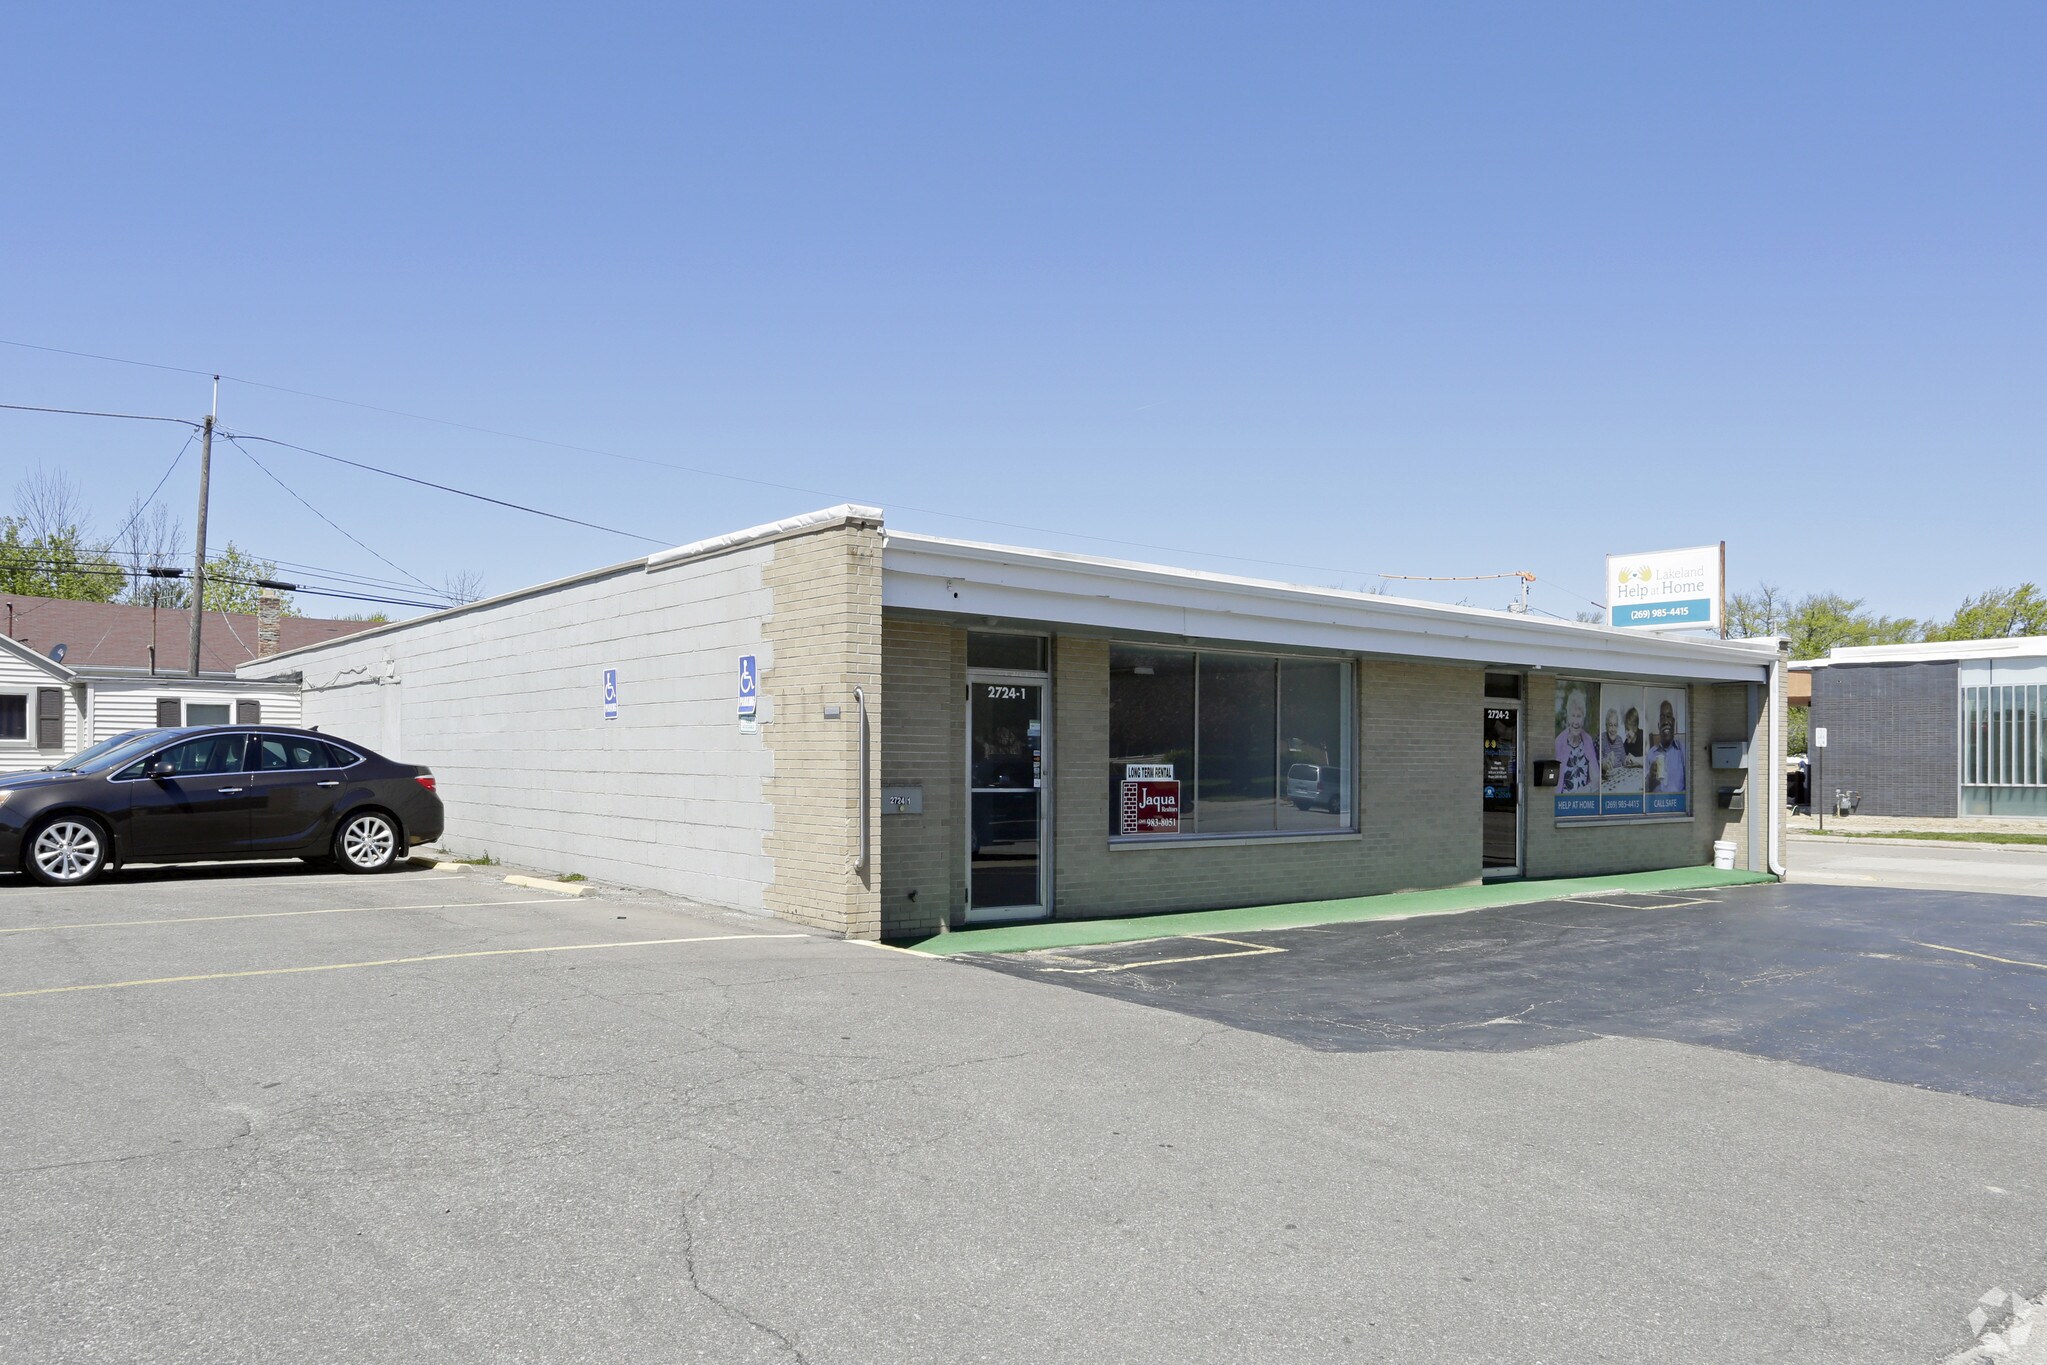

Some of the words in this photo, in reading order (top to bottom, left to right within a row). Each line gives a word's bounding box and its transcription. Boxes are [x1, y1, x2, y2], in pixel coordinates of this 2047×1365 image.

[1656, 565, 1704, 581] Lakeland
[1618, 584, 1648, 599] Help
[1650, 586, 1660, 596] at
[1662, 581, 1704, 594] Home
[1631, 609, 1650, 620] (269)
[1652, 607, 1689, 618] 985-4415
[988, 686, 1026, 700] 2724-1
[1487, 709, 1510, 720] 2724-2
[1128, 767, 1141, 778] LONG
[1142, 767, 1154, 778] TERM
[1155, 767, 1172, 778] RENTAL
[890, 796, 905, 805] 2724
[1139, 788, 1176, 812] Jaqua
[1558, 802, 1571, 810] HELP
[1572, 801, 1579, 809] AT
[1579, 800, 1595, 809] HOME
[1605, 801, 1617, 809] (269)
[1618, 800, 1640, 808] 985-4415
[1654, 800, 1665, 808] CALL
[1665, 799, 1677, 807] SAFE
[1147, 818, 1176, 827] 983-8051
